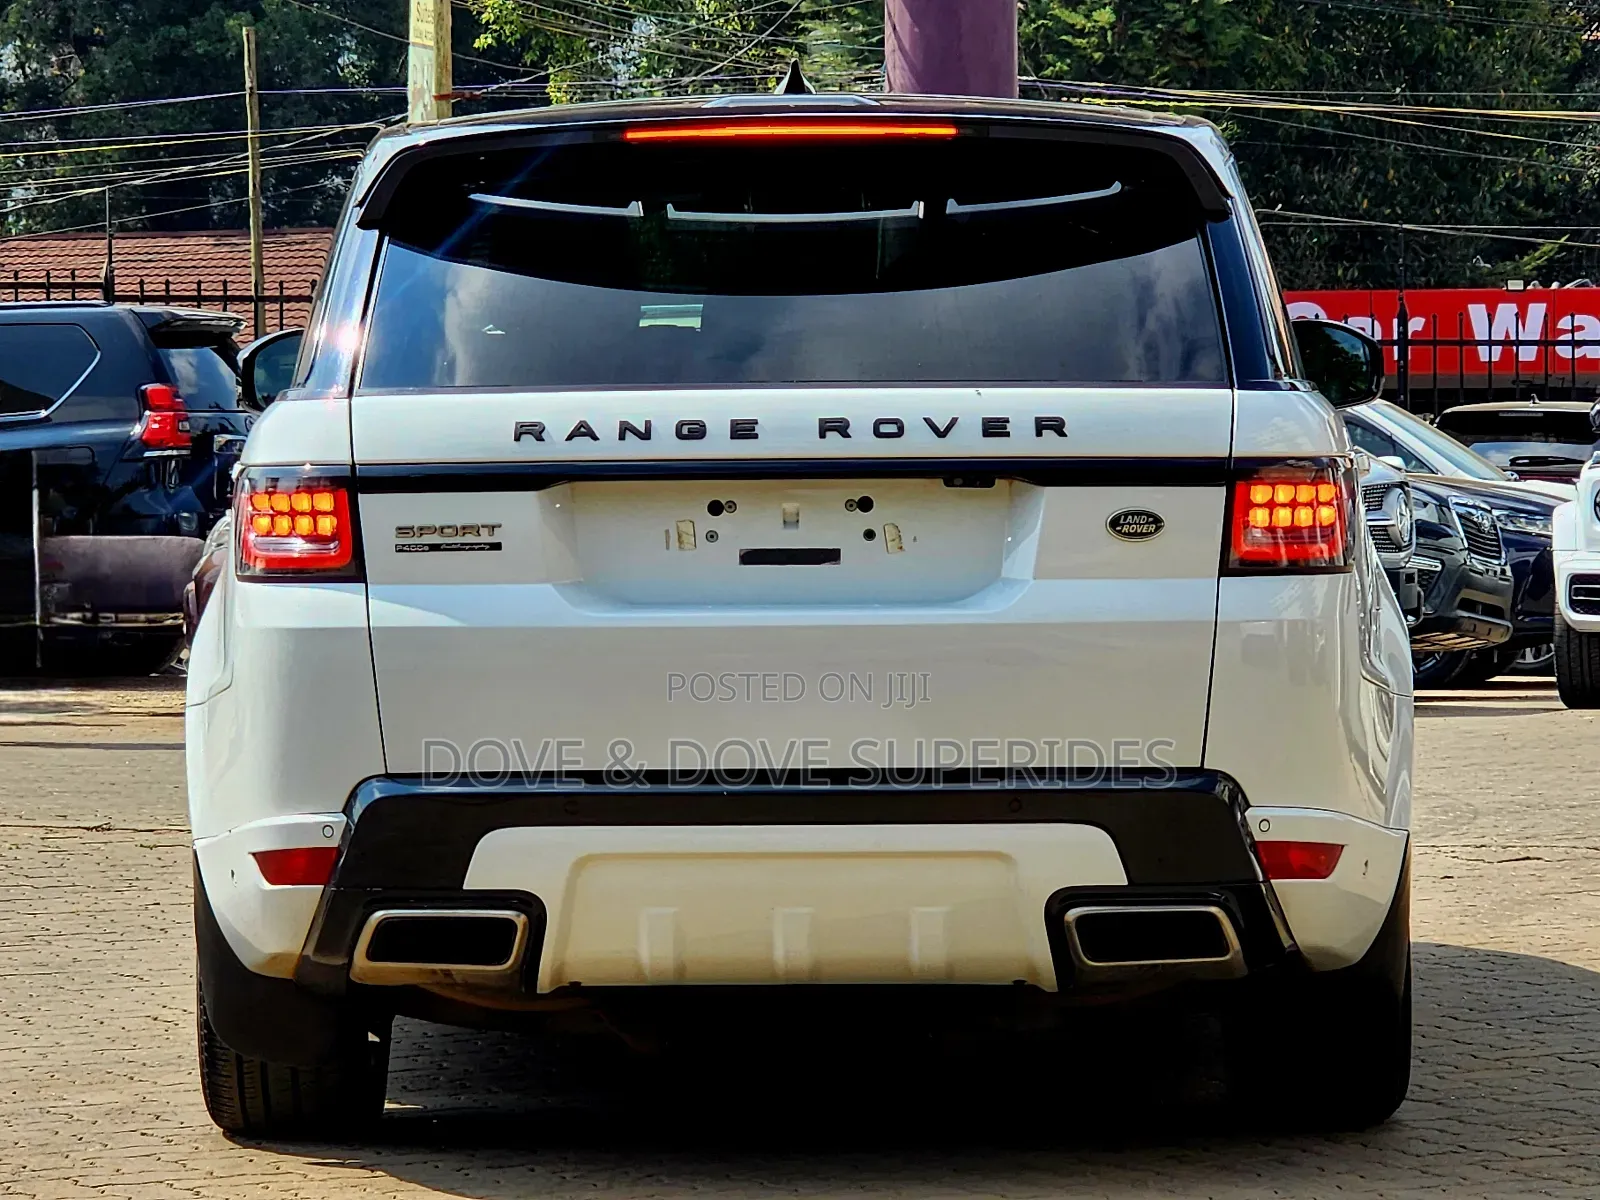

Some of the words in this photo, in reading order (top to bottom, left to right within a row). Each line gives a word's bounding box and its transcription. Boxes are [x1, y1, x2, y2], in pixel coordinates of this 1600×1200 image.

[513, 419, 759, 442] RANGE
[819, 416, 1068, 440] ROVER
[1119, 515, 1147, 524] LAND
[395, 522, 502, 538] SPORT
[1122, 524, 1156, 533] ROVER
